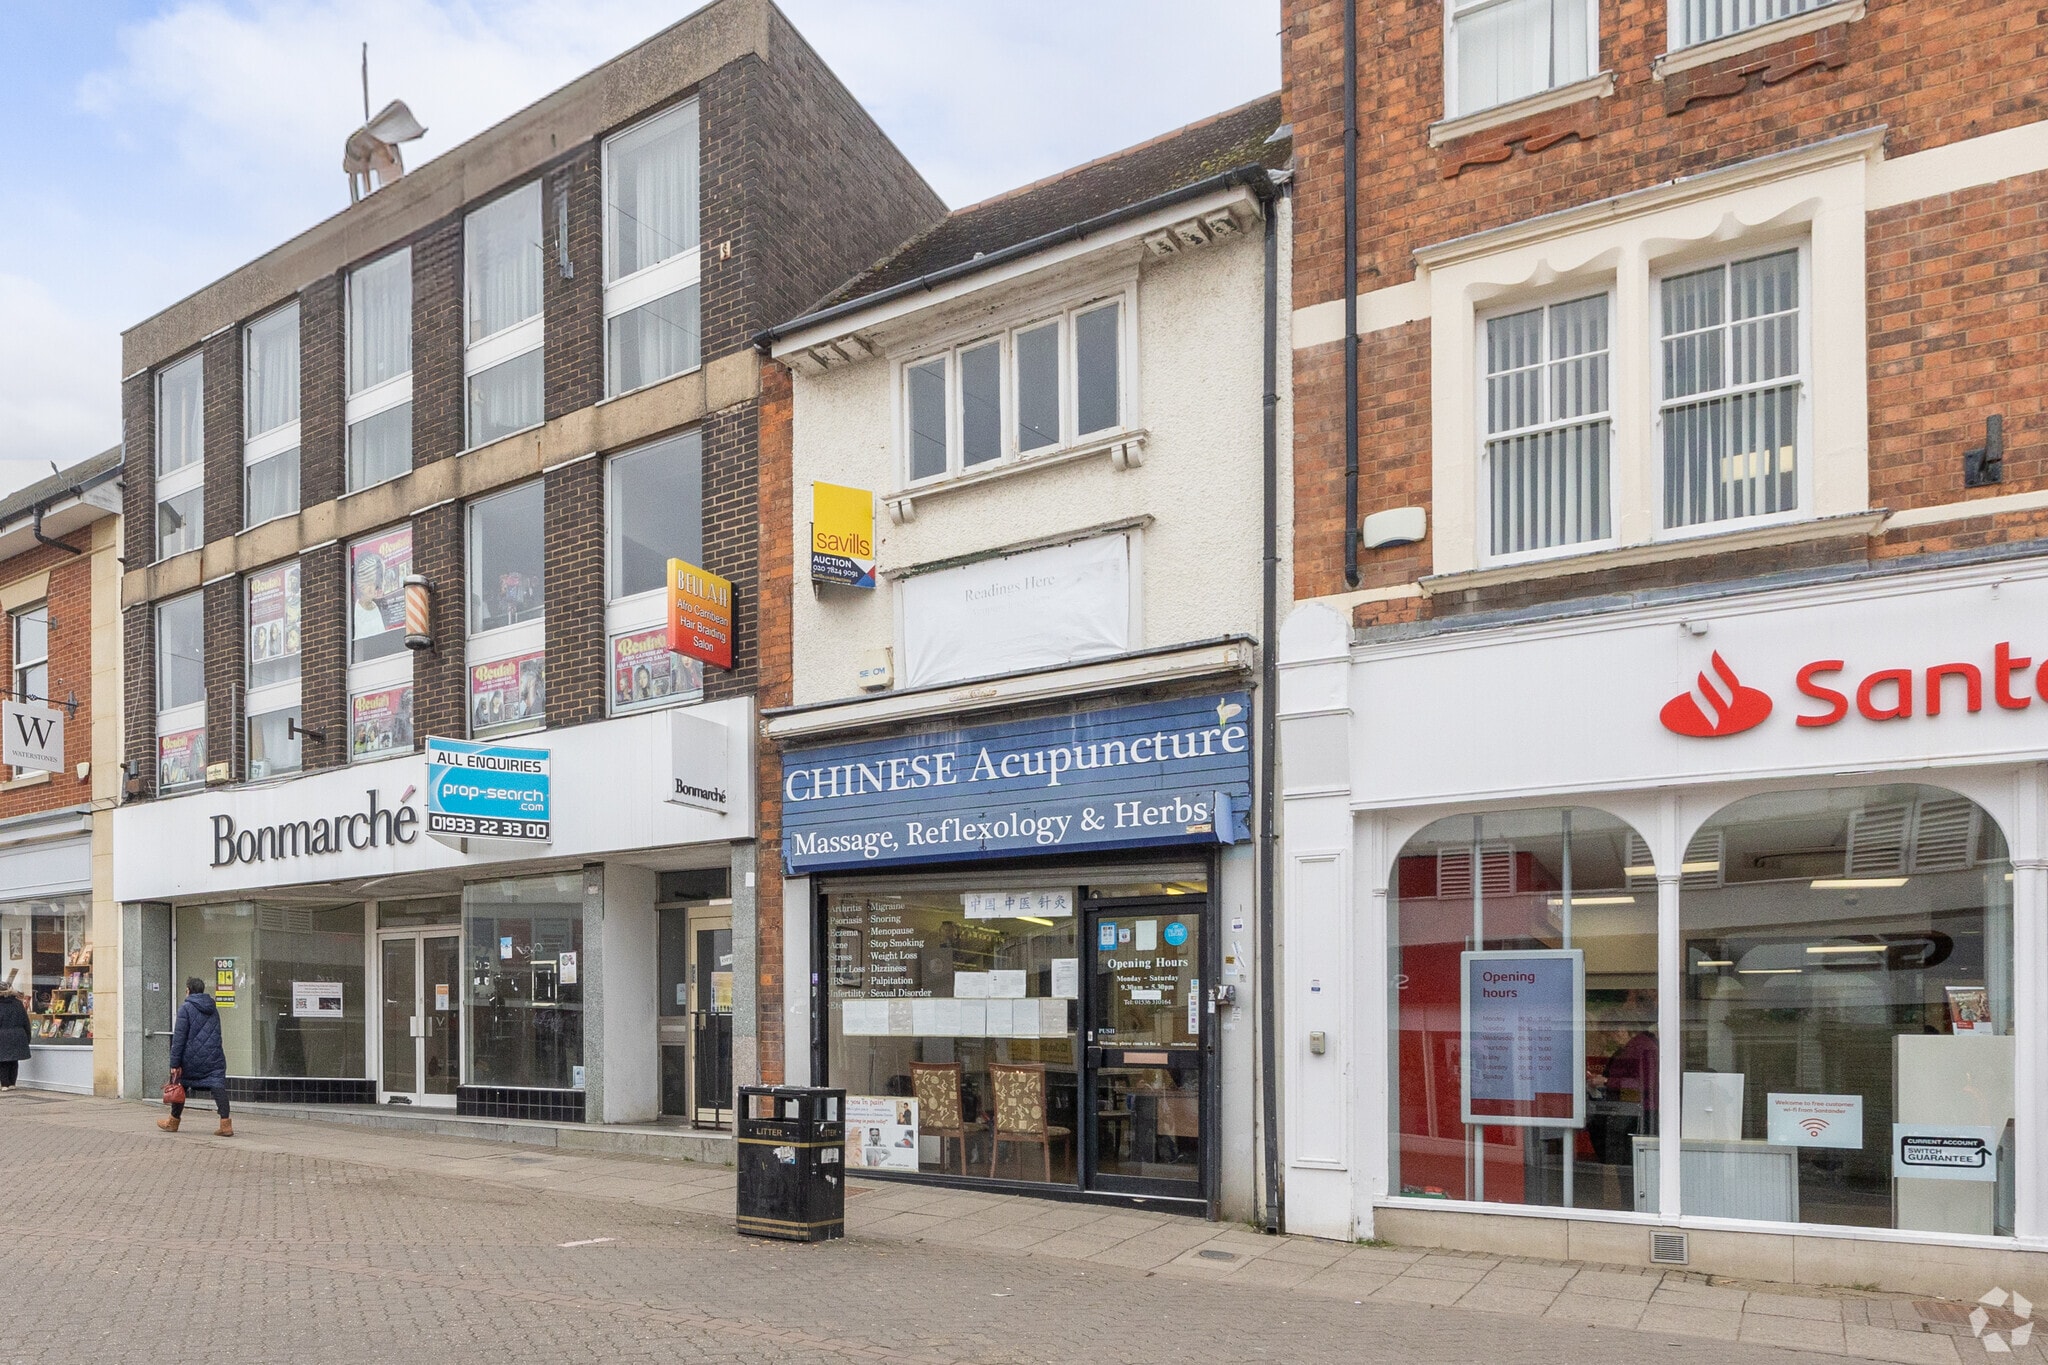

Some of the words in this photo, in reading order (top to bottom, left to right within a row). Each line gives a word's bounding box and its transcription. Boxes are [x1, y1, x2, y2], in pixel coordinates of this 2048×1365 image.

[816, 532, 870, 556] savills
[813, 555, 852, 568] AUCTION
[813, 564, 826, 572] 020
[827, 566, 842, 576] 7824
[843, 569, 858, 578] 9091
[678, 569, 728, 608] BEULAH
[965, 581, 1020, 602] Readings
[1025, 574, 1056, 590] Here
[677, 598, 693, 613] Afro
[694, 605, 729, 627] Carribean
[680, 616, 696, 630] Hair
[697, 621, 726, 644] Braiding
[618, 633, 667, 656] Beulah
[693, 635, 714, 652] Salon
[476, 661, 516, 682] Beulah
[1795, 641, 2048, 727] Sant
[12, 713, 56, 749] W
[12, 750, 58, 763] WATERSTONES
[437, 752, 463, 766] ALL
[467, 755, 542, 773] ENQUIRIES
[785, 751, 957, 802] CHINESE
[968, 725, 1246, 787] Acupuncture
[443, 783, 544, 801] prop-search
[675, 778, 726, 804] Bonmarché
[519, 803, 544, 811] .com
[210, 784, 419, 868] Bonmarché
[432, 815, 475, 833] 01933
[480, 820, 498, 835] 22
[502, 822, 522, 836] 33
[526, 823, 547, 838] 00
[793, 830, 899, 859] Massage,
[906, 812, 1072, 847] Reflexology
[1080, 807, 1105, 832] &
[1114, 797, 1208, 829] Herbs
[830, 904, 862, 913] Arthritis
[870, 903, 905, 912] Migraine
[970, 897, 996, 913] 中国
[1005, 896, 1031, 911] 中医
[1039, 895, 1067, 910] 针灸
[830, 917, 863, 926] Psoriasis
[870, 915, 901, 925] Snoring
[830, 929, 859, 937] Eczema
[870, 927, 914, 937] Menopause
[830, 941, 848, 949] Acne
[870, 939, 888, 949] Stop
[889, 938, 925, 948] Smoking
[829, 953, 853, 961] Stress
[870, 951, 898, 961] Weight
[900, 950, 918, 960] Loss
[829, 965, 848, 973] Hair
[849, 964, 866, 973] Loss
[871, 964, 907, 973] Dizziness
[1108, 958, 1151, 970] Opening
[1156, 957, 1188, 967] Hours
[829, 977, 844, 986] IBS
[870, 976, 914, 986] Palpitation
[1149, 974, 1178, 982] Saturday
[1483, 971, 1536, 984] Opening
[830, 989, 865, 999] Infertility
[870, 989, 896, 998] Sexual
[898, 988, 933, 998] Disorder
[1483, 988, 1518, 998] hours
[756, 1127, 783, 1137] LITTER
[1943, 1139, 1978, 1147] ACCOUNT
[1908, 1153, 1973, 1163] GUARANTEE
